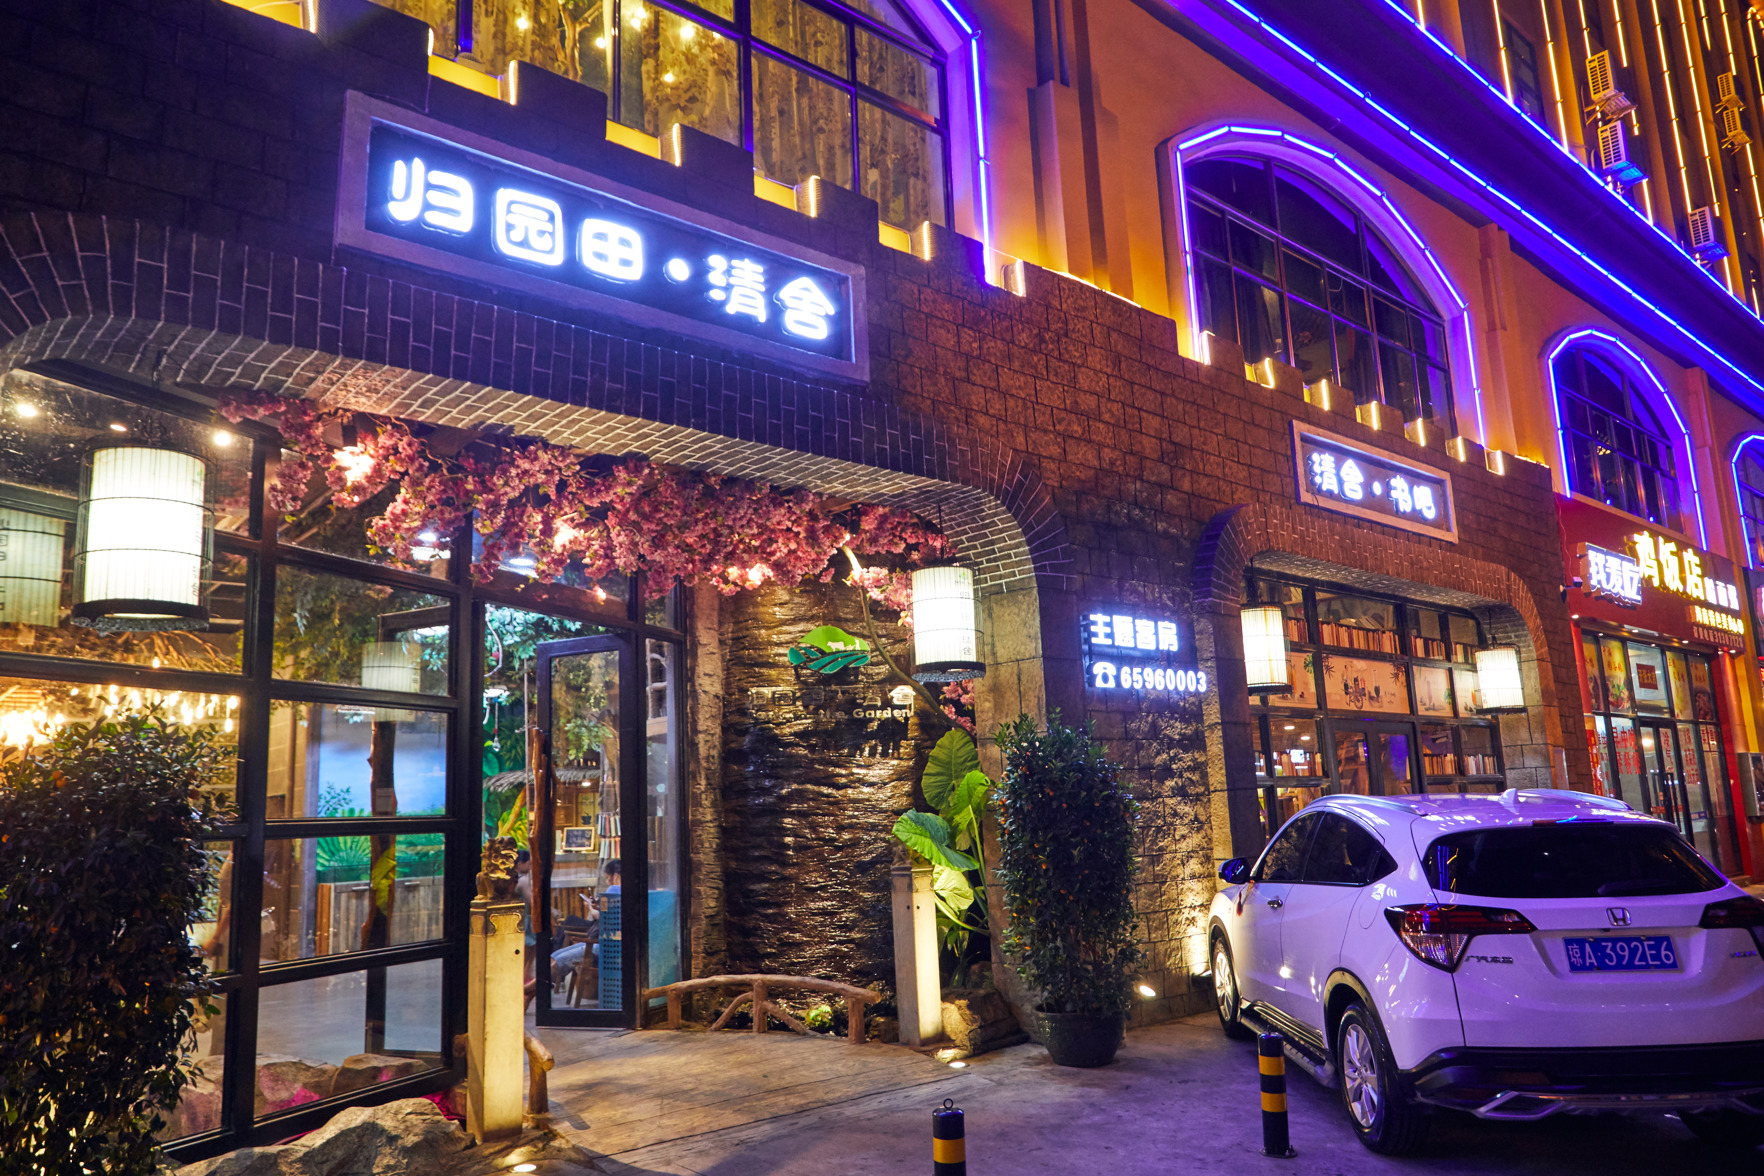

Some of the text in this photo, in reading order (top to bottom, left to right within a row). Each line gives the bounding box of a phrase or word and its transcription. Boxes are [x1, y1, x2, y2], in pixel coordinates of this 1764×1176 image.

[389, 157, 835, 340] 归园田·清舍
[1311, 452, 1436, 520] 清舍·书吧
[1089, 613, 1179, 652] 主题客房
[1120, 666, 1207, 693] 65960003
[852, 706, 911, 719] Garden
